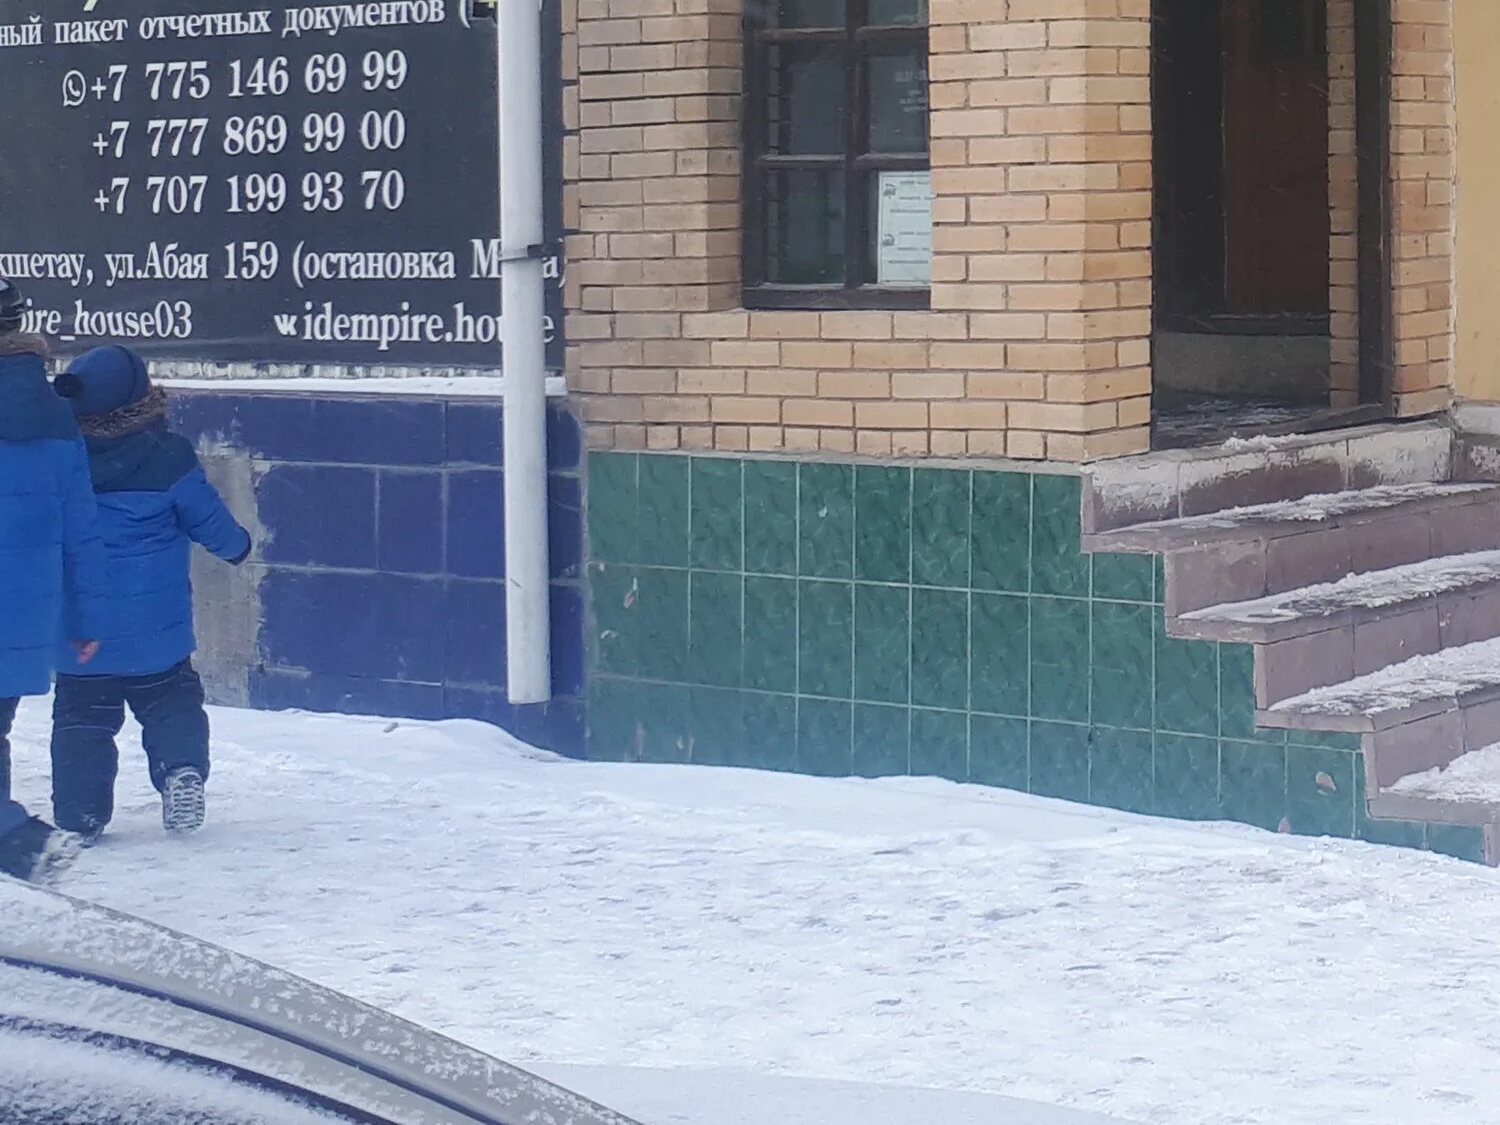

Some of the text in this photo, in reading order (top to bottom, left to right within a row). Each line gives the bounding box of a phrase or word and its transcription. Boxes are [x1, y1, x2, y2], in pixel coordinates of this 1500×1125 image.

[54, 19, 128, 44] пакет
[139, 9, 271, 40] отчетных
[91, 50, 407, 102] +7 775 146 69 99
[93, 110, 405, 158] +7 777 869 99 00
[94, 170, 404, 214] +7 707 199 93 70
[104, 241, 208, 287] ул.Абая
[224, 241, 279, 279] 159
[293, 240, 455, 288] (остановка
